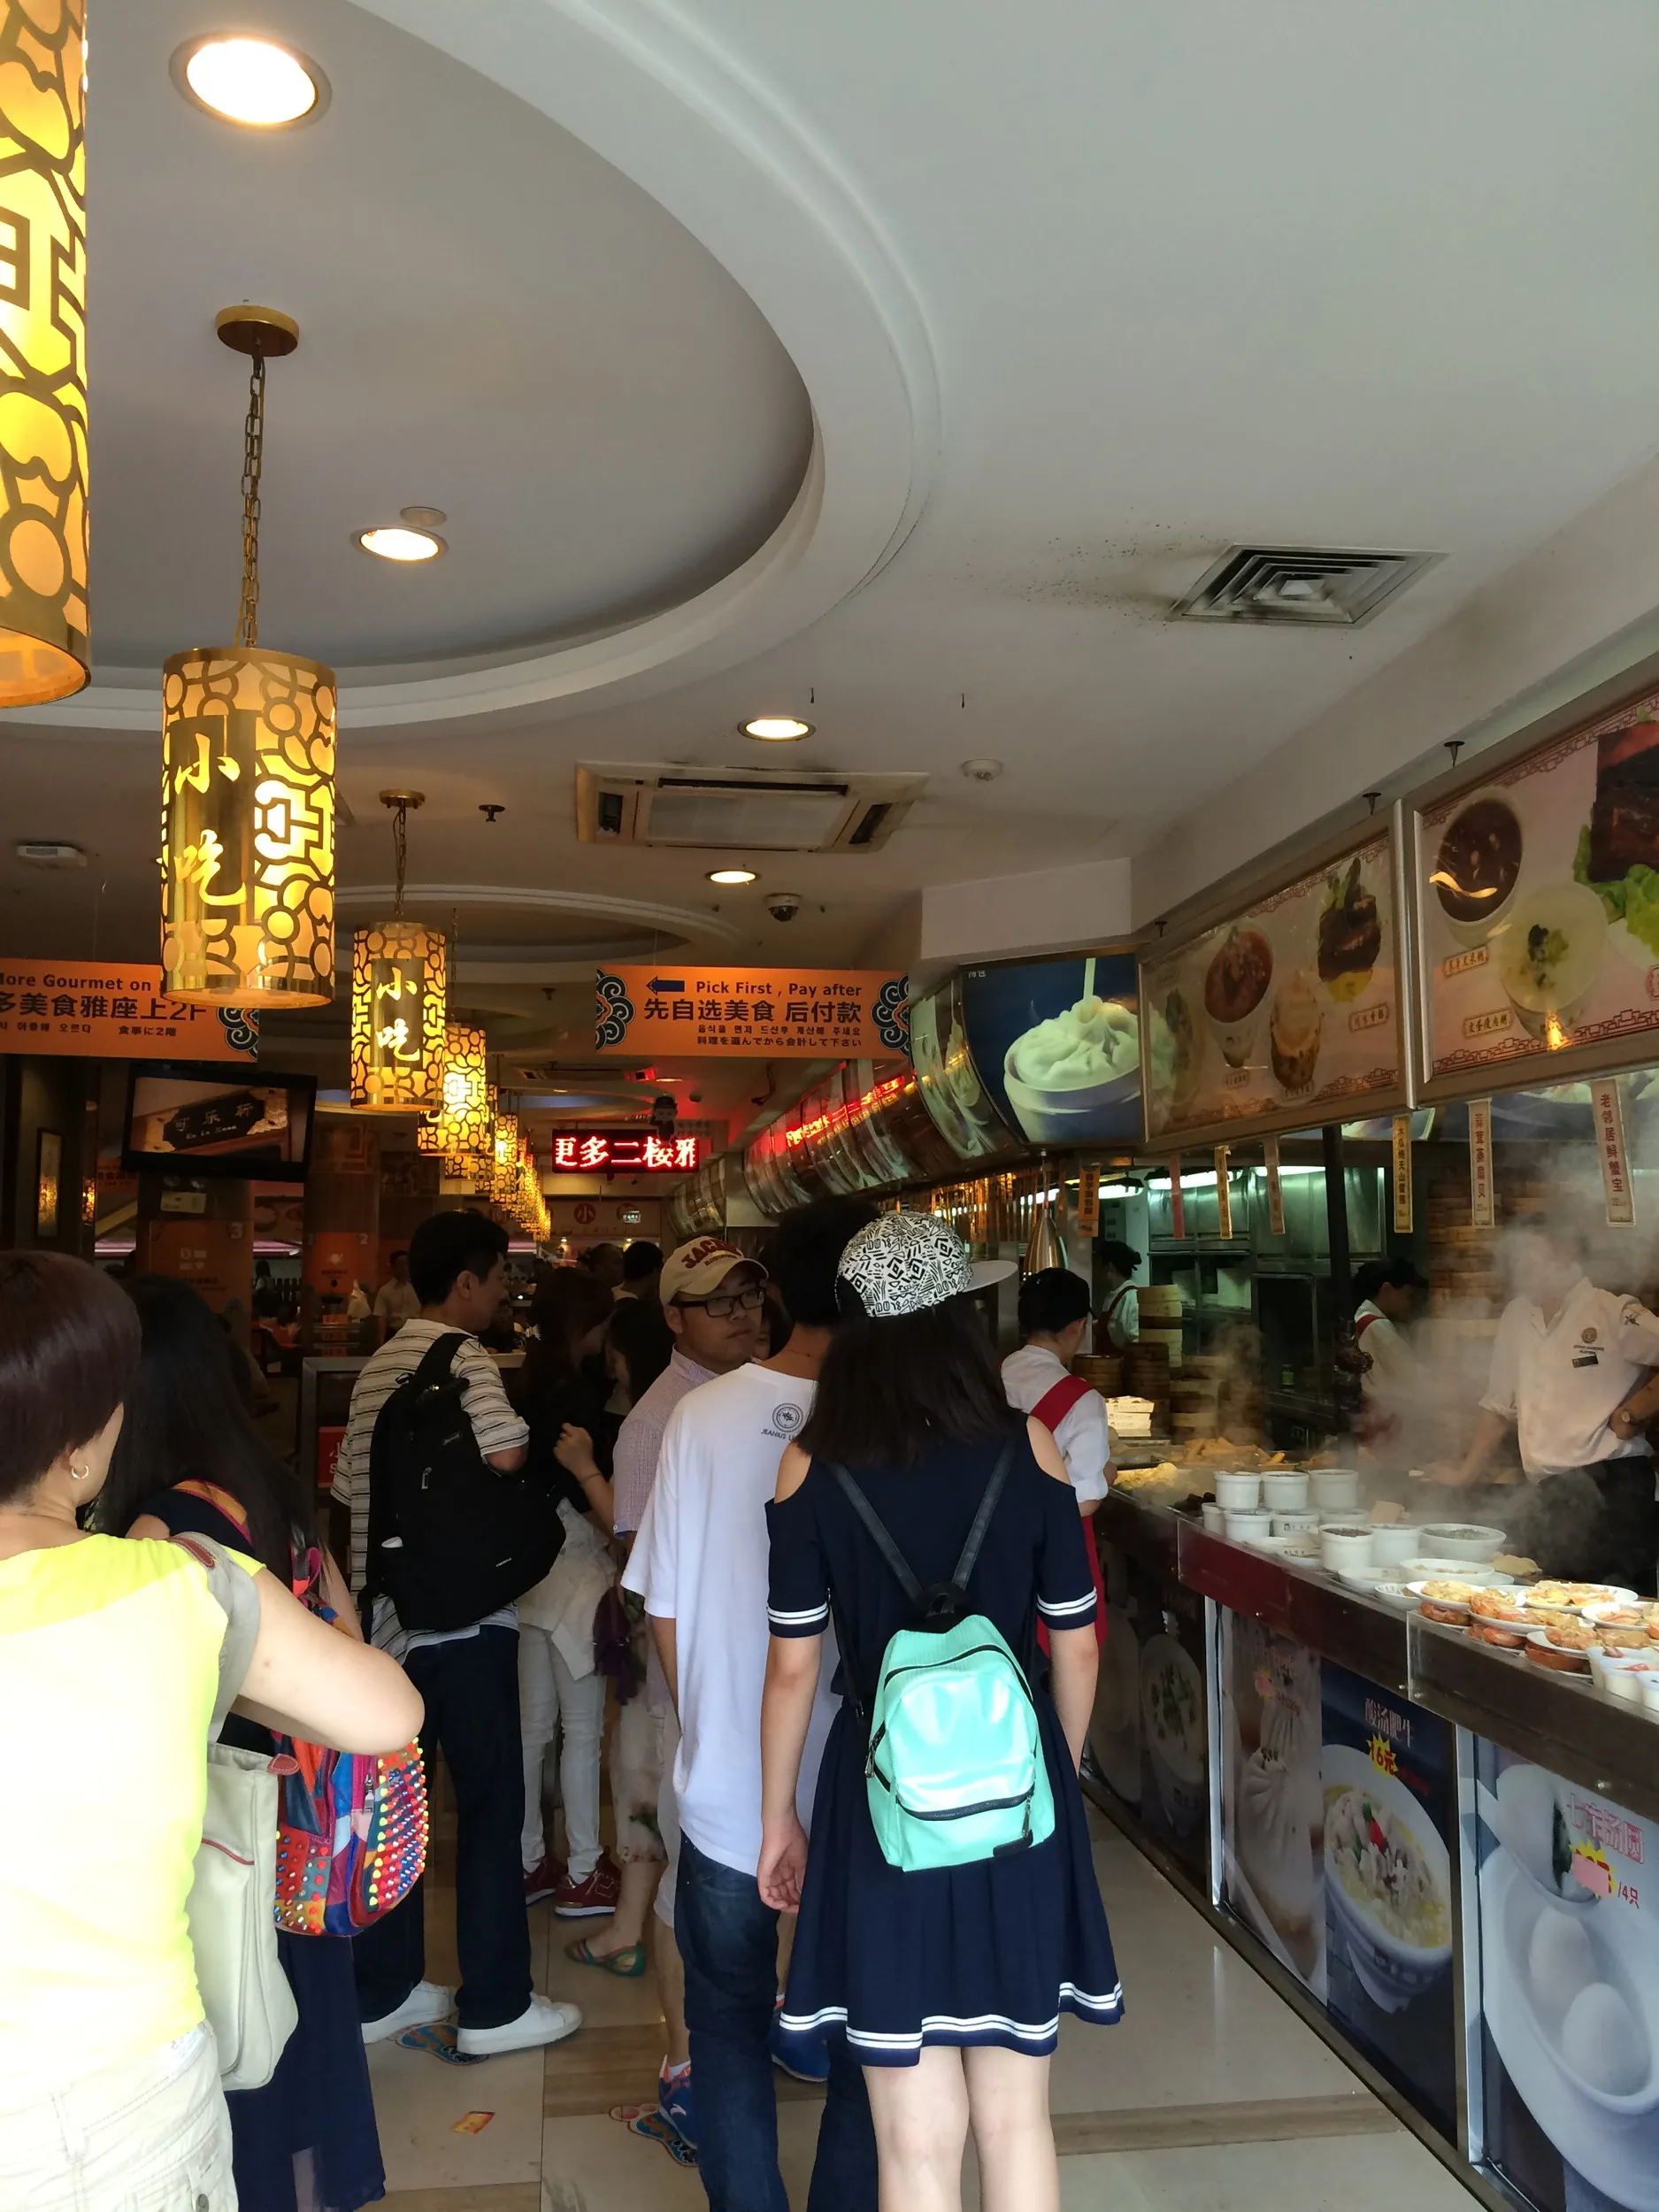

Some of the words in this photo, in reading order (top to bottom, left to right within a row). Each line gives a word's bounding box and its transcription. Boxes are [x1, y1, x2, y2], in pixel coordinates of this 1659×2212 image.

[0, 973, 36, 987] ore
[42, 974, 124, 990] Gourmet
[129, 979, 151, 991] on
[696, 979, 729, 994] Pick
[736, 980, 772, 995] First
[788, 982, 819, 997] Pay
[823, 983, 862, 997] after
[643, 998, 775, 1022] 先自选美食
[786, 1001, 862, 1024] 后付款
[1370, 1740, 1396, 1777] 16元
